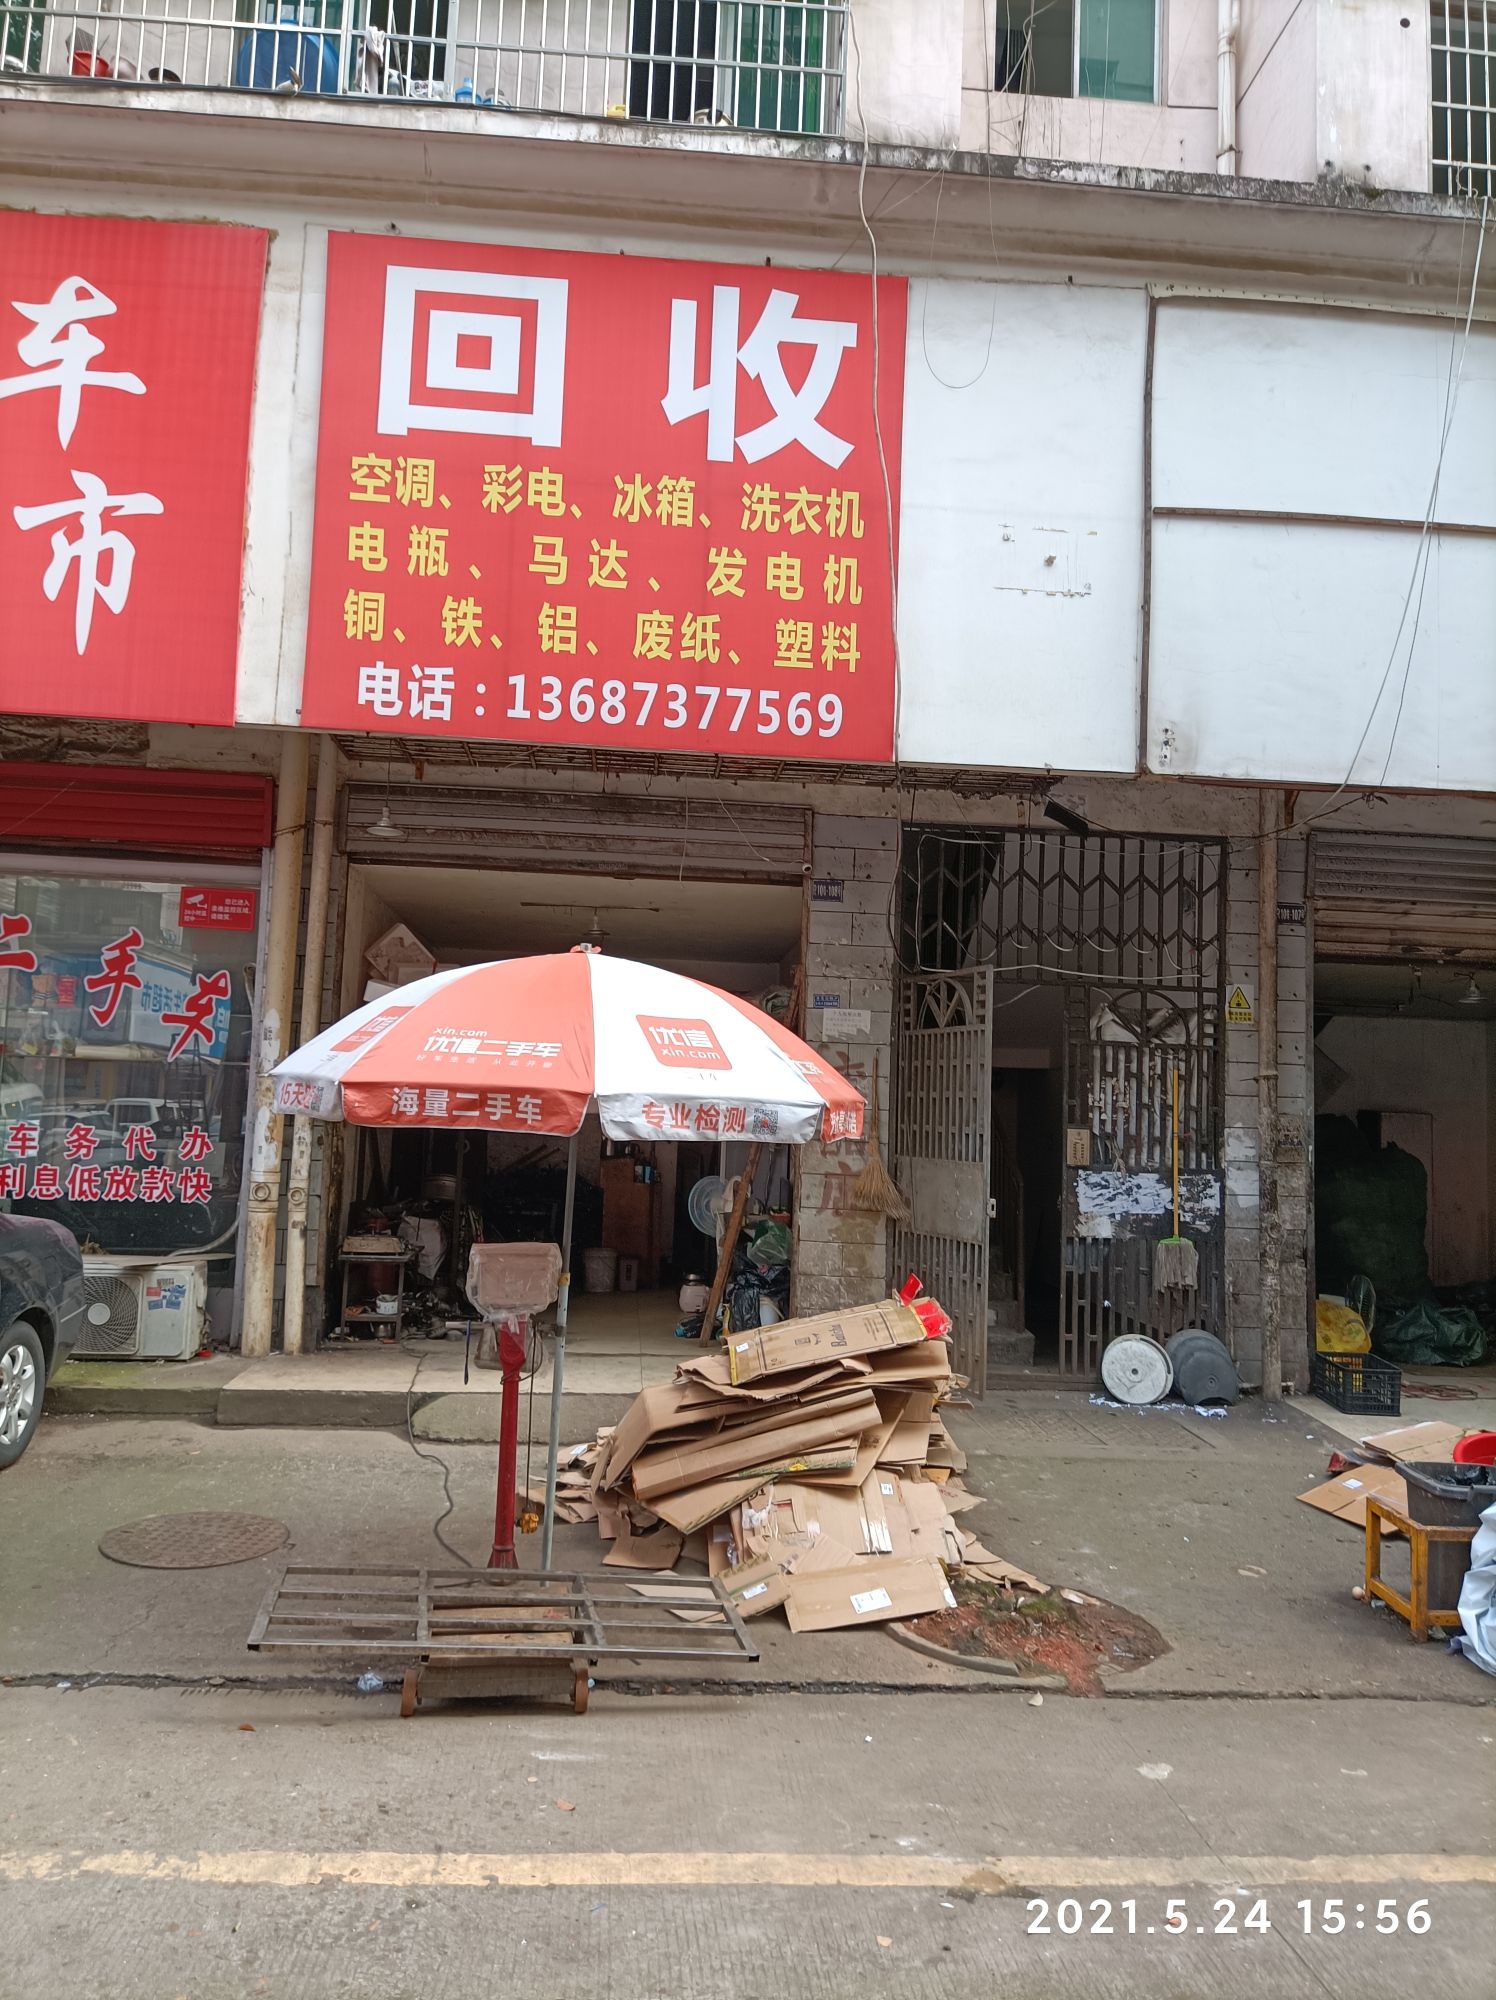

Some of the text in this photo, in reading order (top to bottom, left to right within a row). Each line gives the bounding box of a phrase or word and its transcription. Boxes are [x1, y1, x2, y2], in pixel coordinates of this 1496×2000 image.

[377, 265, 858, 470] 回收
[423, 1036, 563, 1058] 优信二手车
[433, 1026, 488, 1038] xin.com
[648, 1025, 714, 1049] 优信
[661, 1047, 721, 1061] xin.com
[391, 1086, 543, 1125] 海量二手车
[641, 1101, 748, 1134] 专业检测
[7, 1121, 214, 1162] 车务代办
[0, 1163, 213, 1204] 利息低放款快
